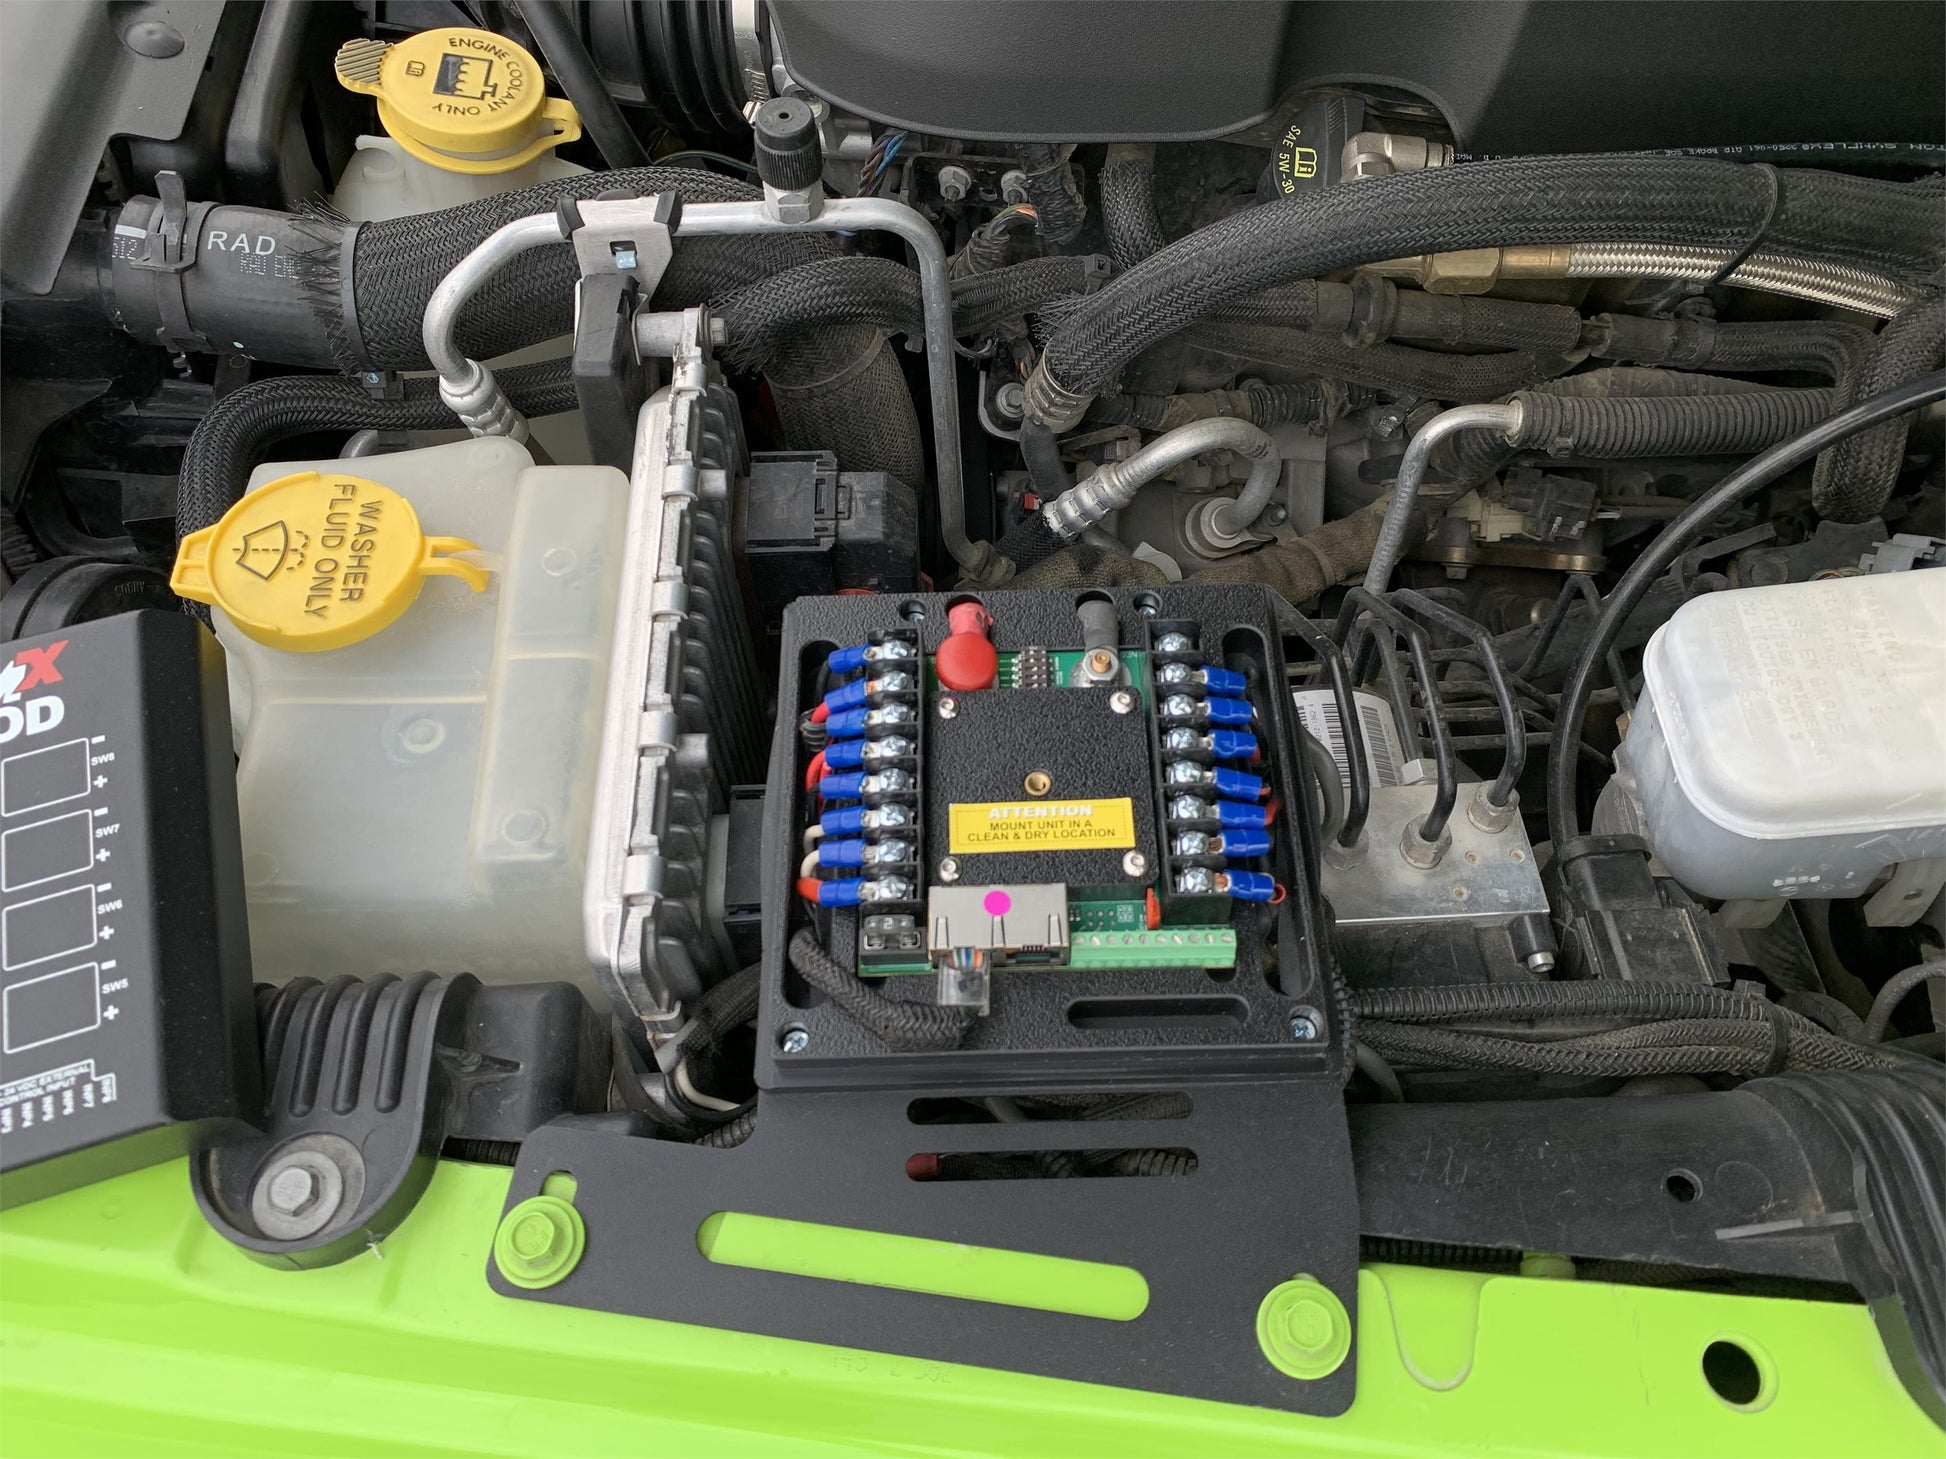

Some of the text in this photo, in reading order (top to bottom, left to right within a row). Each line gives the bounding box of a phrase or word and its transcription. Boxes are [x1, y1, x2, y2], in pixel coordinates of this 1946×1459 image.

[432, 37, 524, 116] ENGINE COOLANT ONLY
[1278, 125, 1302, 194] SAE 5W-30
[207, 231, 276, 256] RAD
[304, 483, 356, 618] FLUID ONLY
[339, 499, 384, 602] WASHER
[91, 752, 115, 766] SW8
[989, 804, 1094, 820] ATTENTION
[95, 823, 120, 838] SW7
[990, 819, 1093, 831] MOUNT UNIT IN A
[968, 829, 1116, 842] CLEAN & DRY LOCATION
[97, 899, 123, 914] SW6
[882, 917, 894, 931] 2
[102, 978, 129, 994] SW5
[39, 1064, 91, 1086] EXTERNAL
[46, 1077, 76, 1092] INPUT
